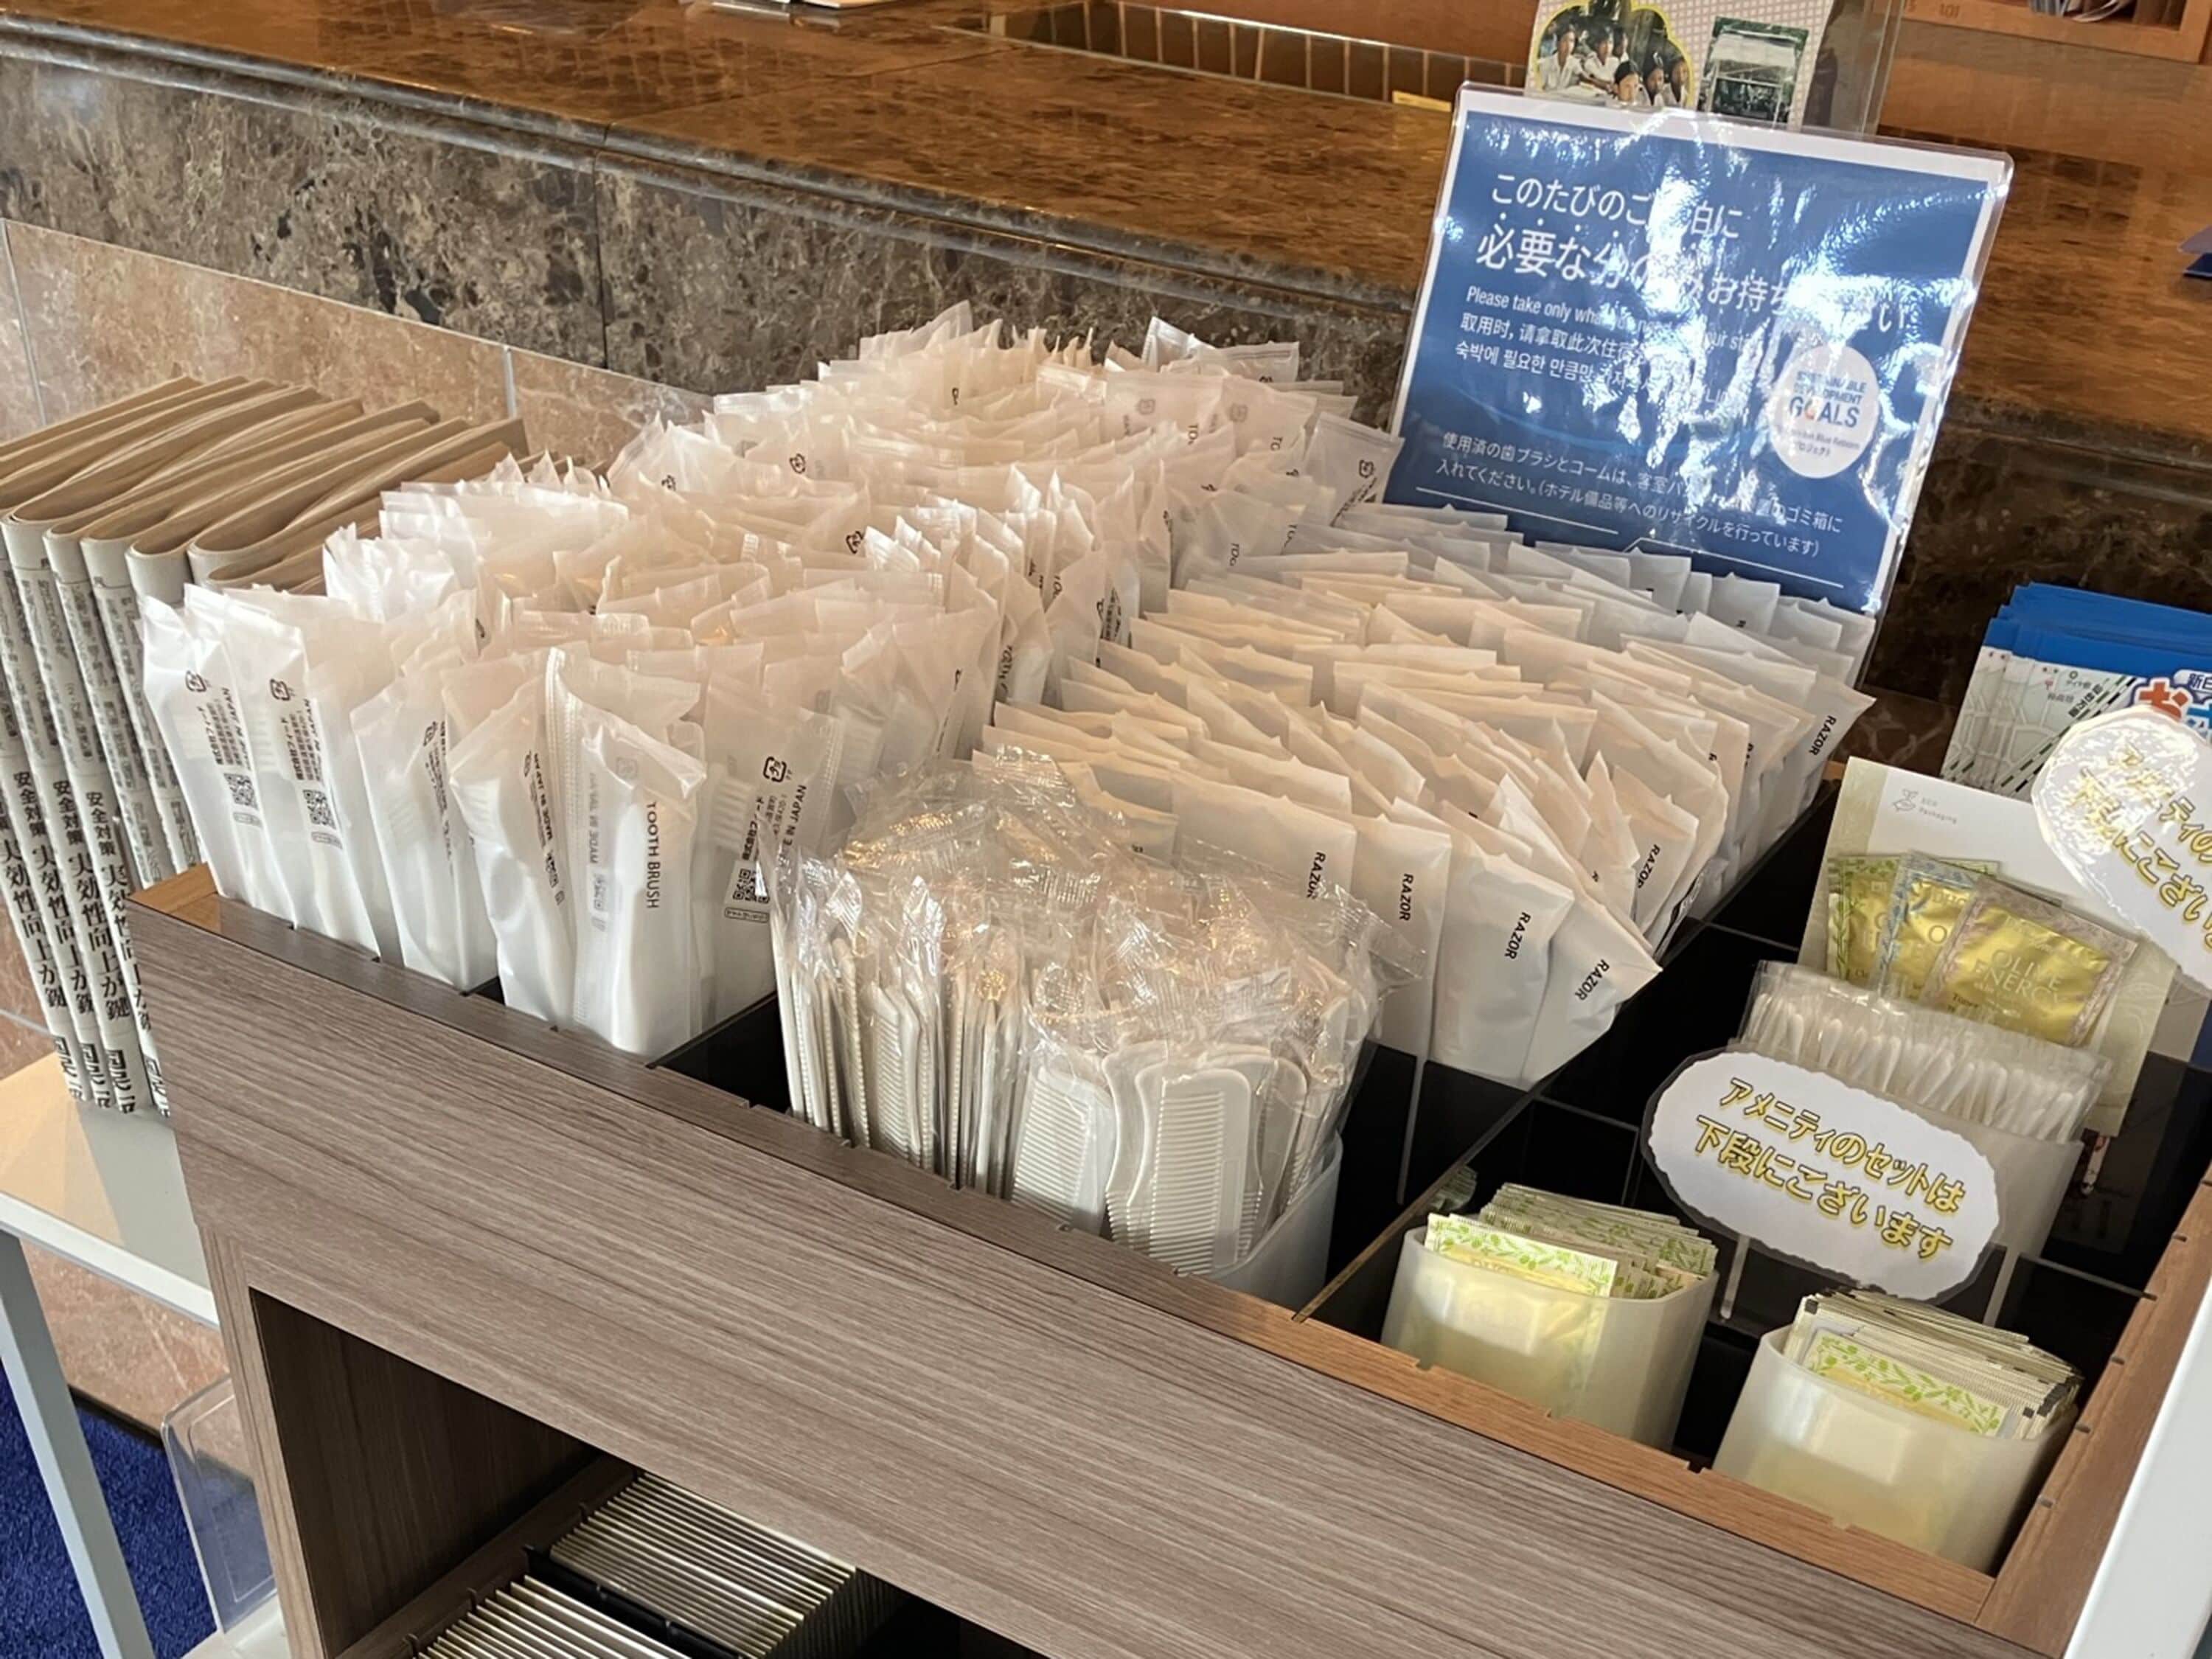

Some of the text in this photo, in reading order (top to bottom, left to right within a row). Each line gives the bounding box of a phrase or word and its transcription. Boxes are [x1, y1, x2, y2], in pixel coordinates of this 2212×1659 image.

[1492, 174, 1743, 238] このたびのご泊に
[1466, 286, 1509, 310] Please
[1512, 295, 1542, 315] take
[1544, 302, 1572, 324] only
[1809, 714, 1837, 756] RAZOR
[86, 791, 116, 856] 安全対策
[790, 784, 807, 824] JAPAN
[647, 801, 661, 909] TOOTH BRUSH
[1399, 873, 1413, 921] RAZOR
[1504, 911, 1531, 959] RAZOR
[1575, 959, 1610, 1001] RAZOR
[1719, 1077, 1968, 1215] アメニティのセットは
[1694, 1115, 1954, 1260] 下段にございます
